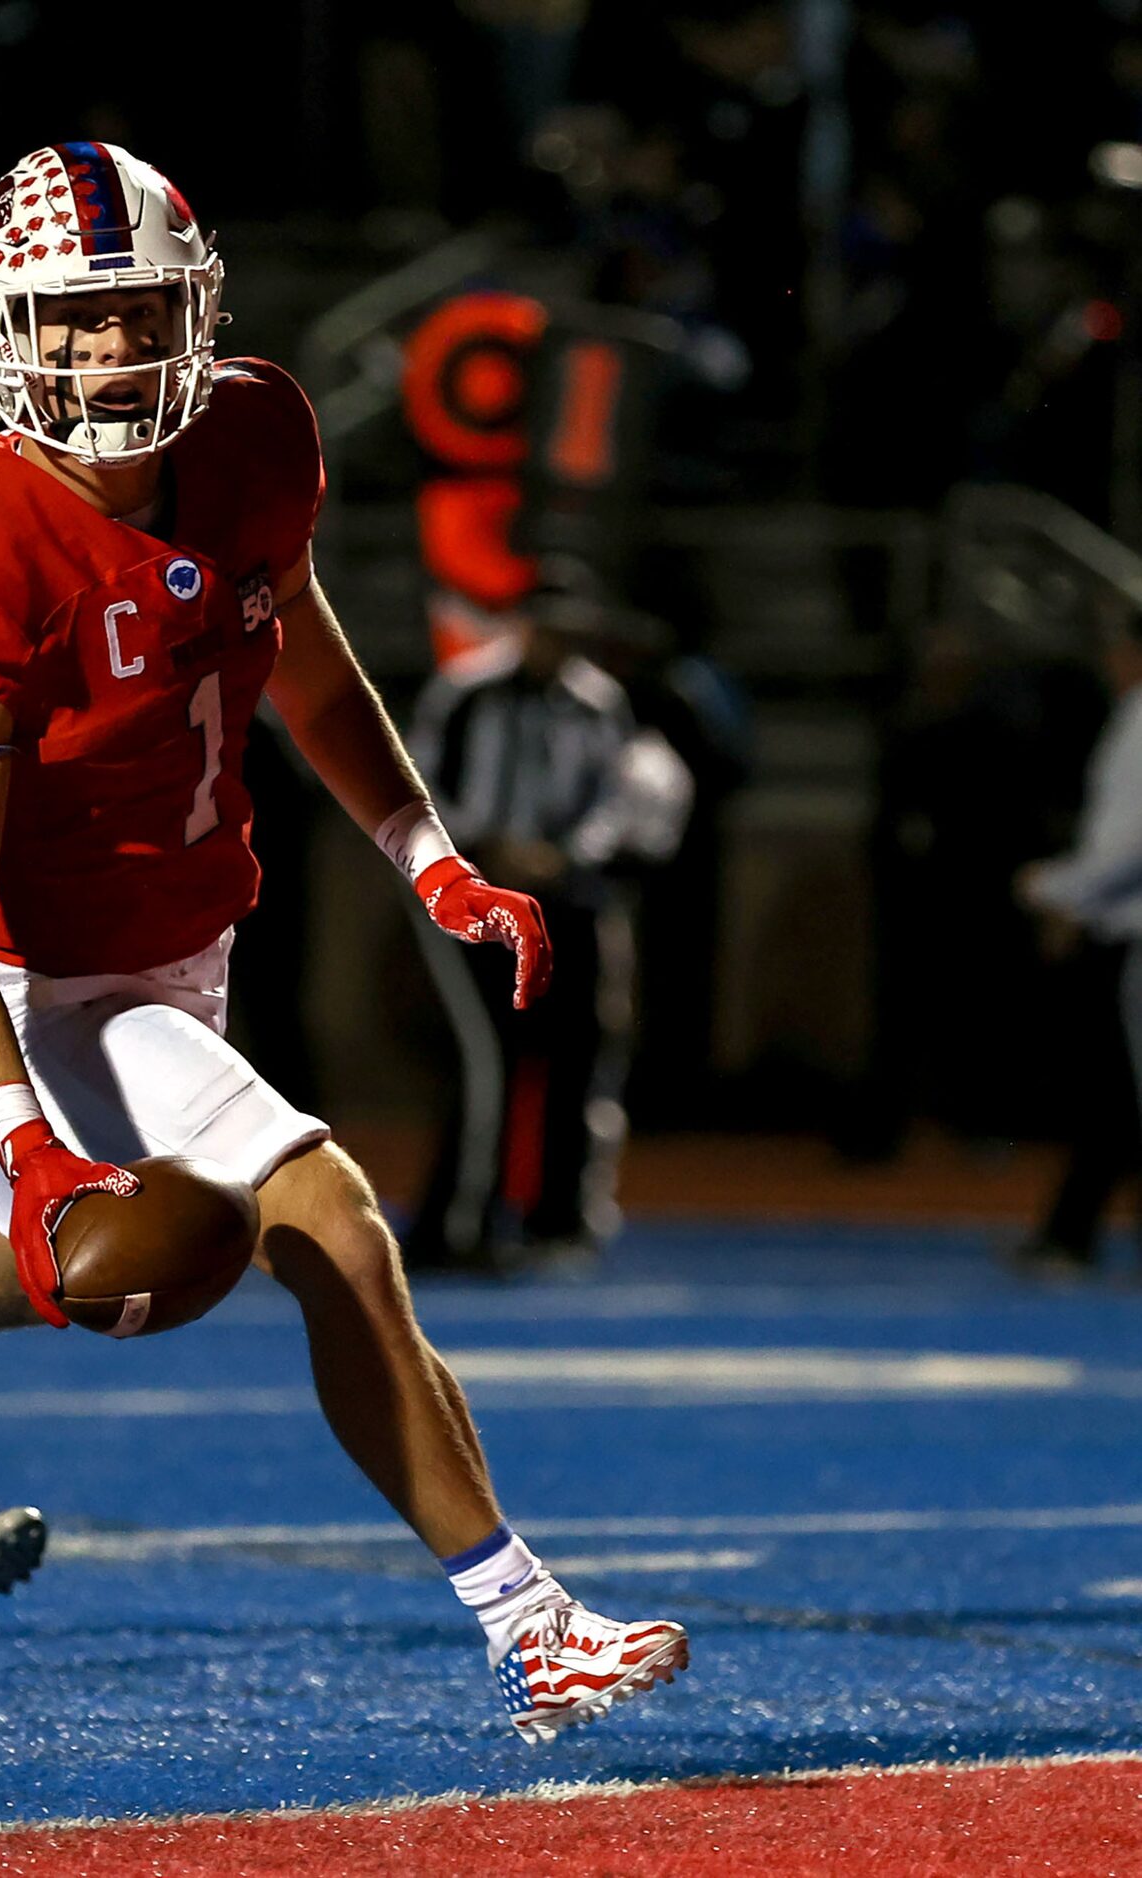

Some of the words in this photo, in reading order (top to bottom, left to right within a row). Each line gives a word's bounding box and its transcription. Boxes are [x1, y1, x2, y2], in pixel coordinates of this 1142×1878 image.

[104, 600, 145, 679] C
[242, 585, 273, 633] 50
[184, 670, 223, 847] 1
